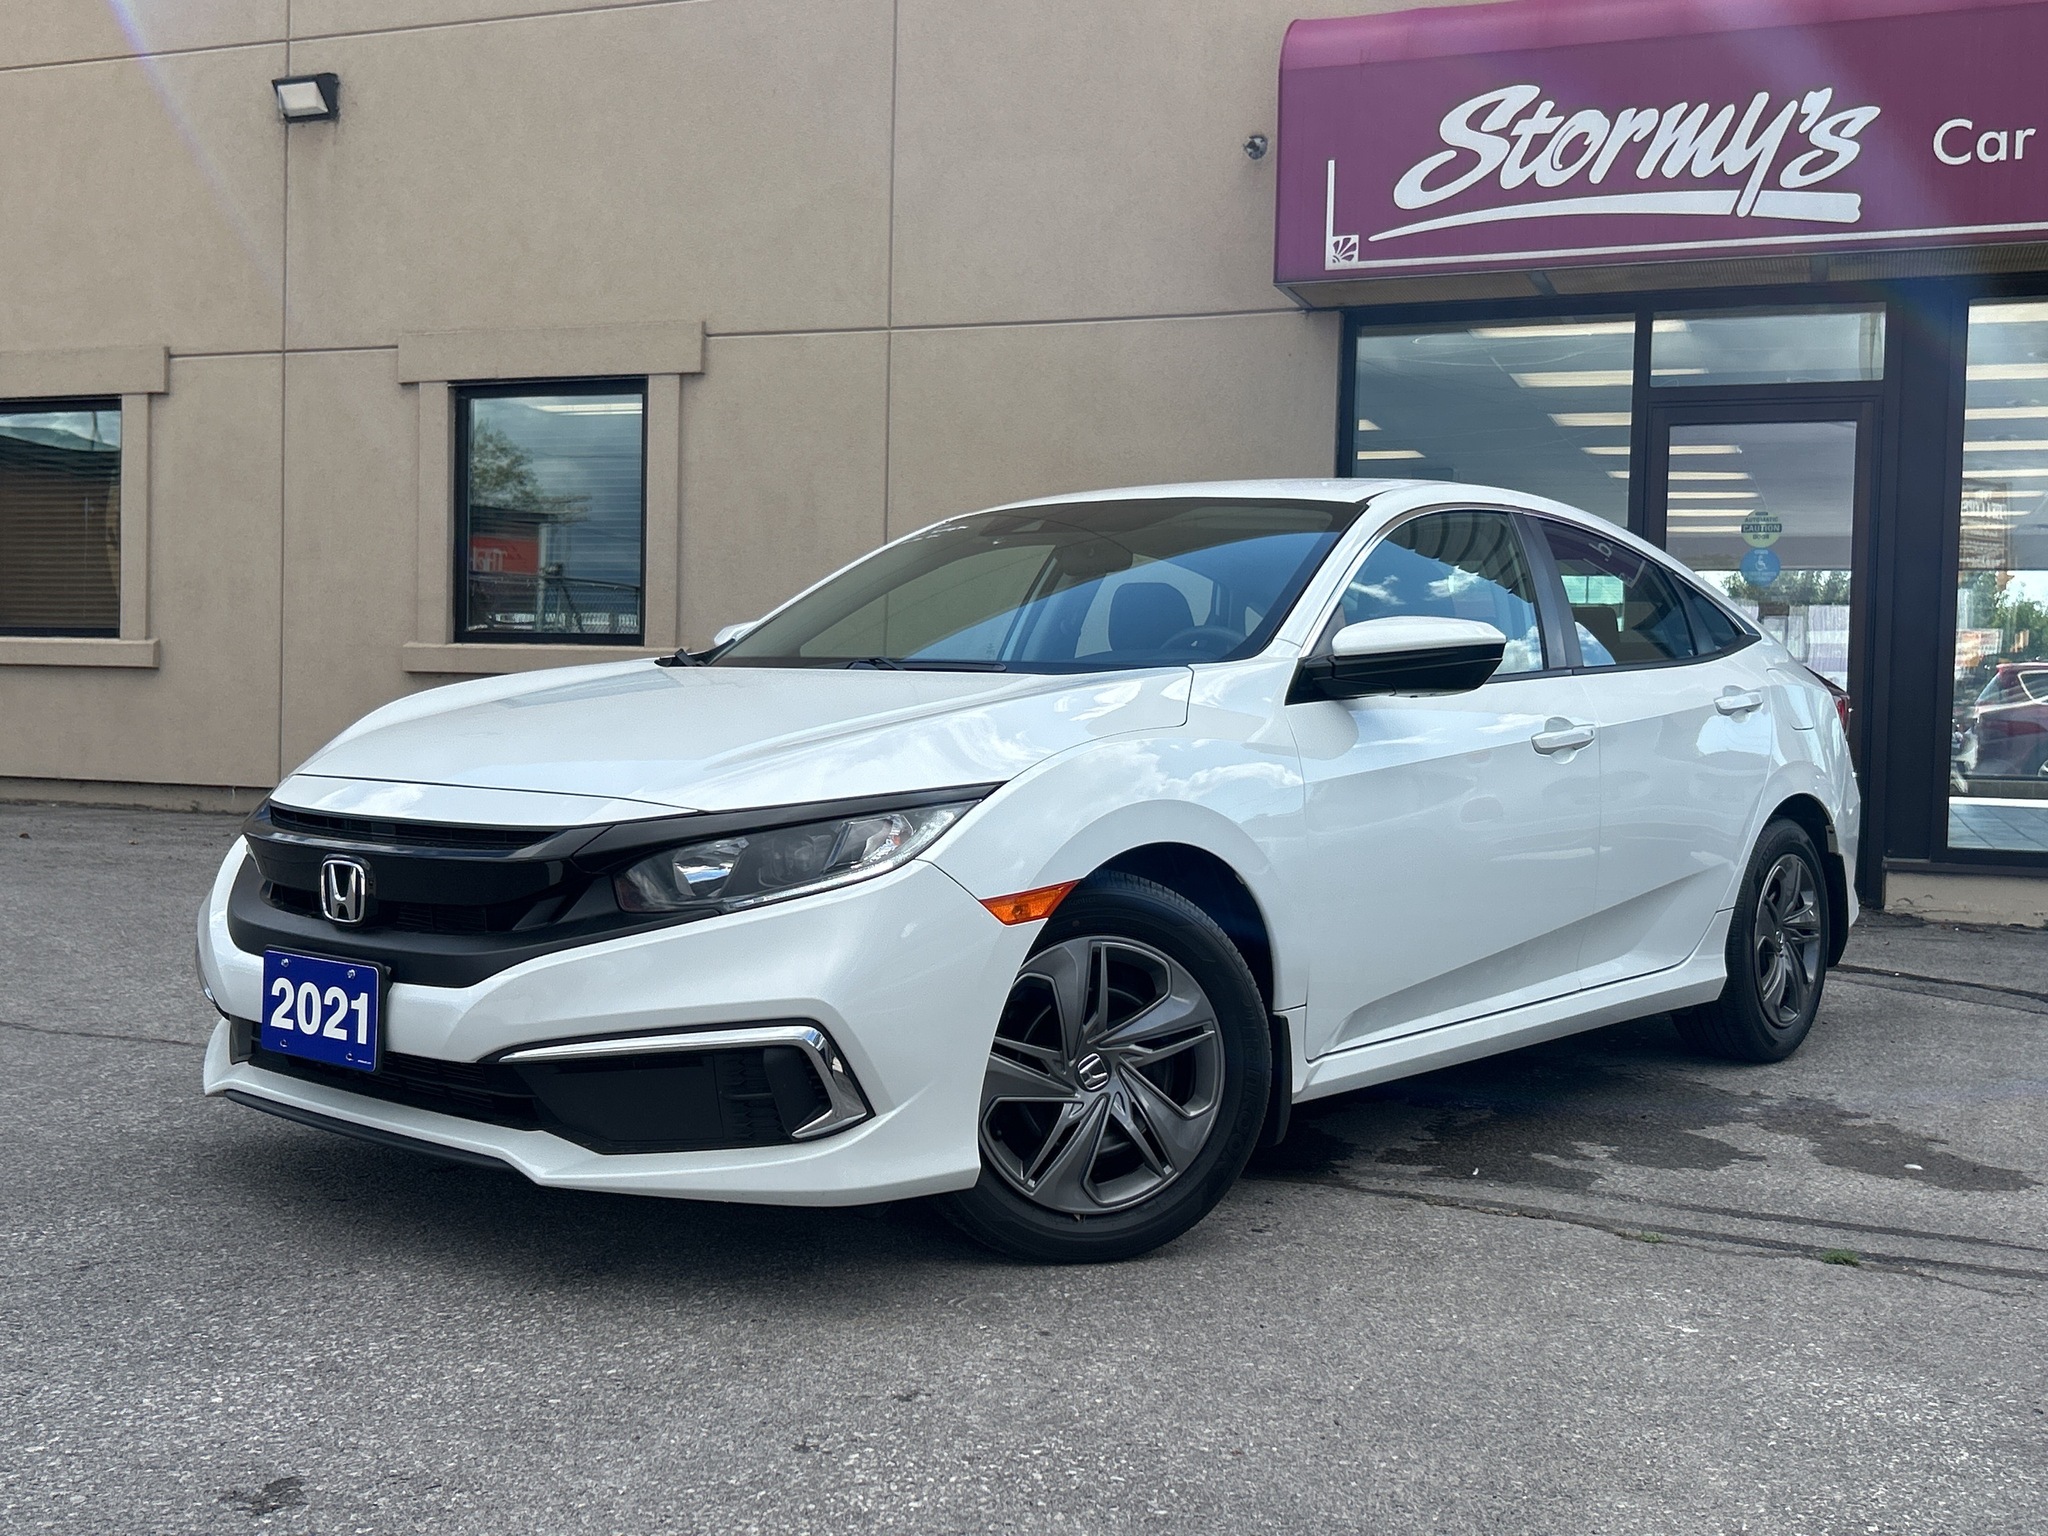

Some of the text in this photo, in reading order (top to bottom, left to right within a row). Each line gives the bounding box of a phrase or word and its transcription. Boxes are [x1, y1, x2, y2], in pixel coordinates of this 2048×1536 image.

[1393, 84, 2036, 217] Stormy's Car
[1743, 524, 1780, 533] CAUTION
[271, 977, 368, 1045] 2021
